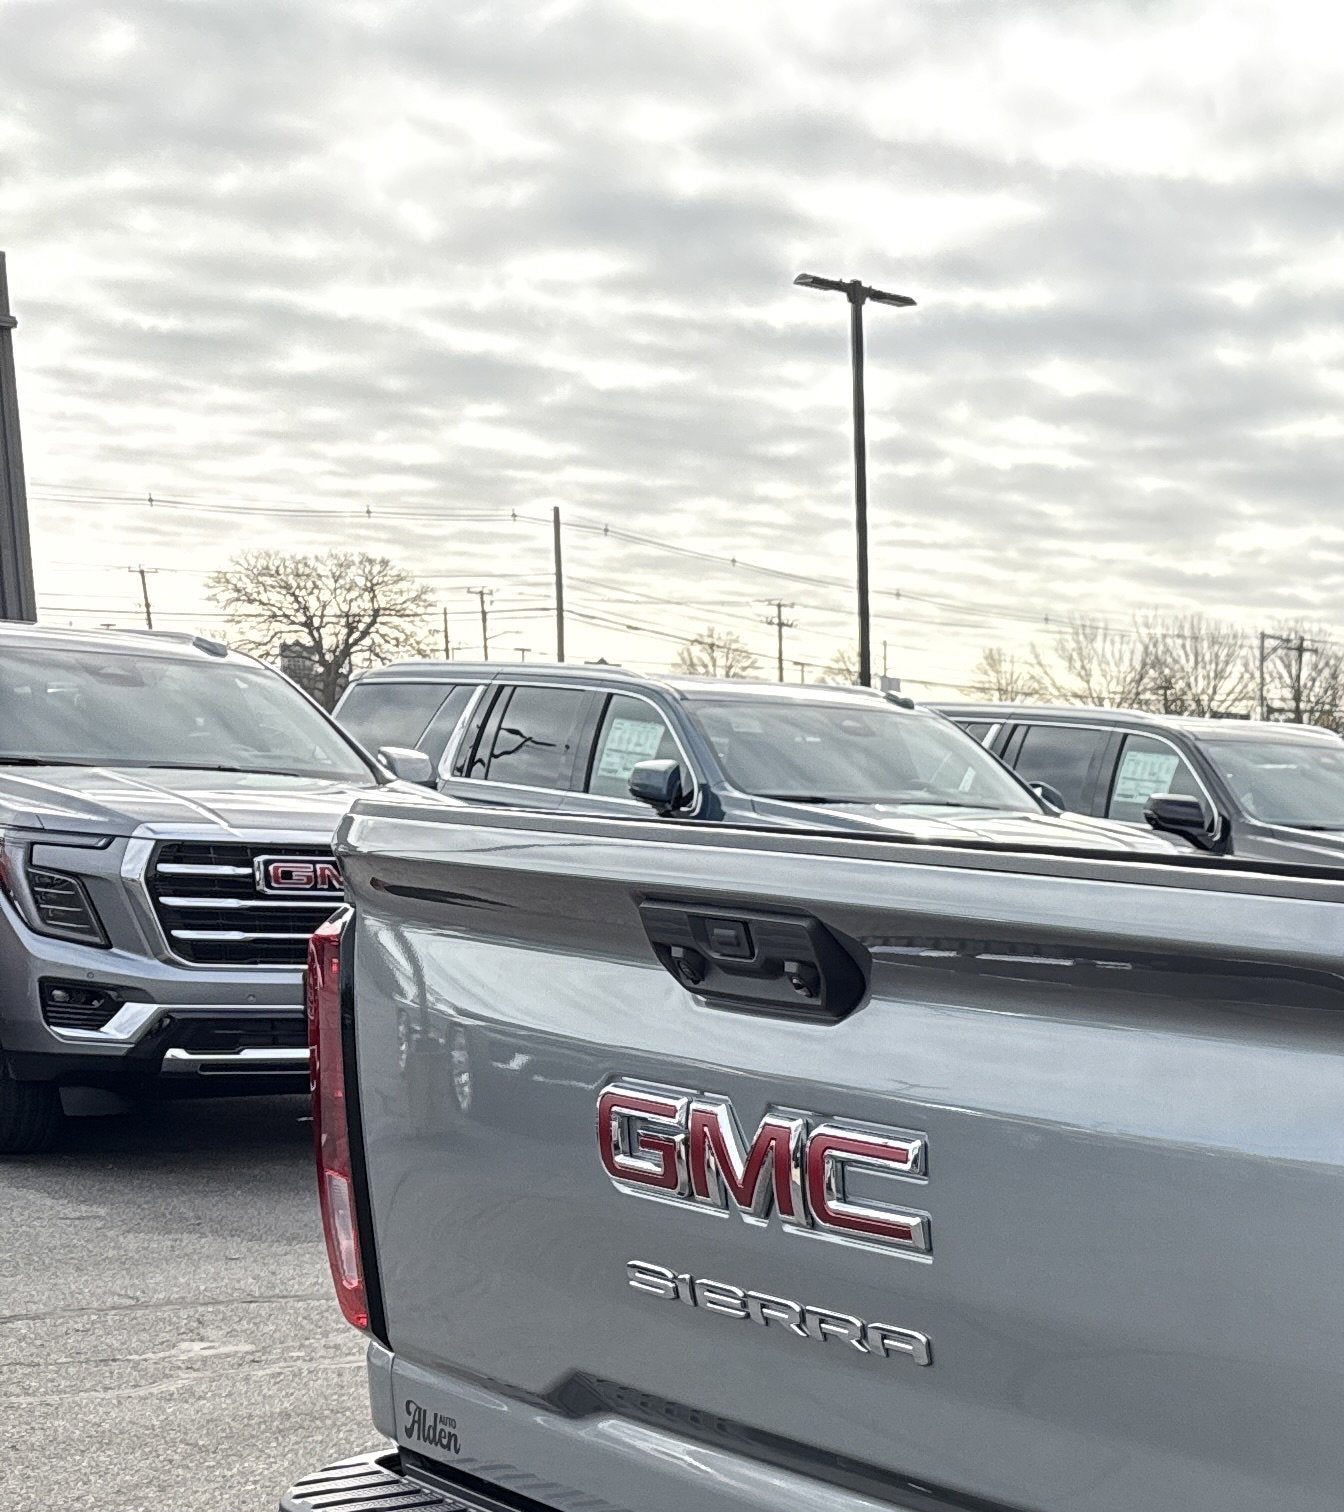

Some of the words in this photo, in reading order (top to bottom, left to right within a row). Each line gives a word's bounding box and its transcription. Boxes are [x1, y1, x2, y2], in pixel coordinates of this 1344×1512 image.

[596, 1075, 934, 1265] GMC
[626, 1268, 933, 1367] SIERRA
[404, 1399, 461, 1455] Alden
